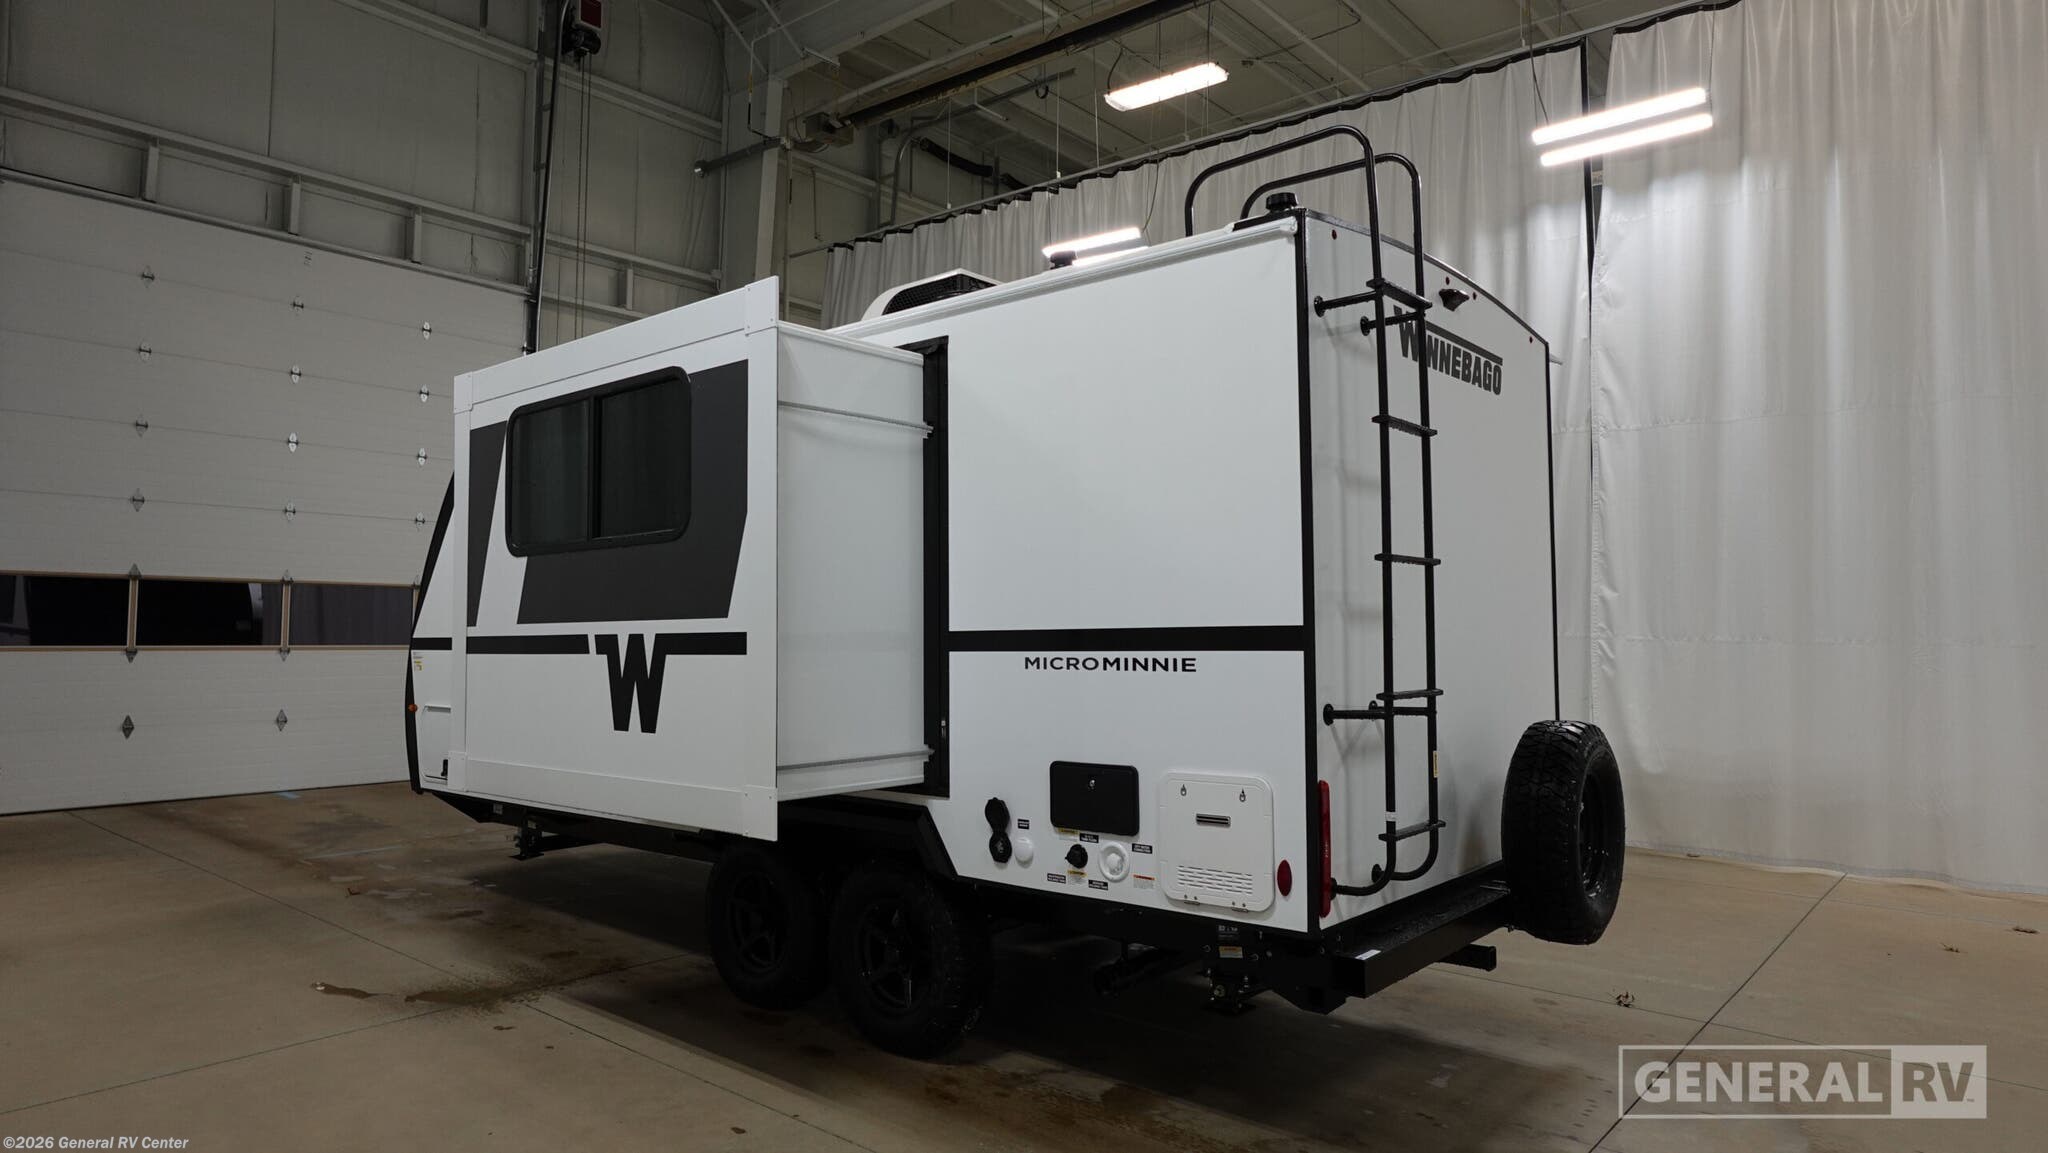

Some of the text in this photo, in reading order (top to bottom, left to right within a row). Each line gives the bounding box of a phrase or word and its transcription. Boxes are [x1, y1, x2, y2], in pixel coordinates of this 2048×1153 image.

[1393, 305, 1503, 396] WNNEBAGO
[595, 633, 667, 734] W
[1024, 656, 1197, 673] MICROMINNIE
